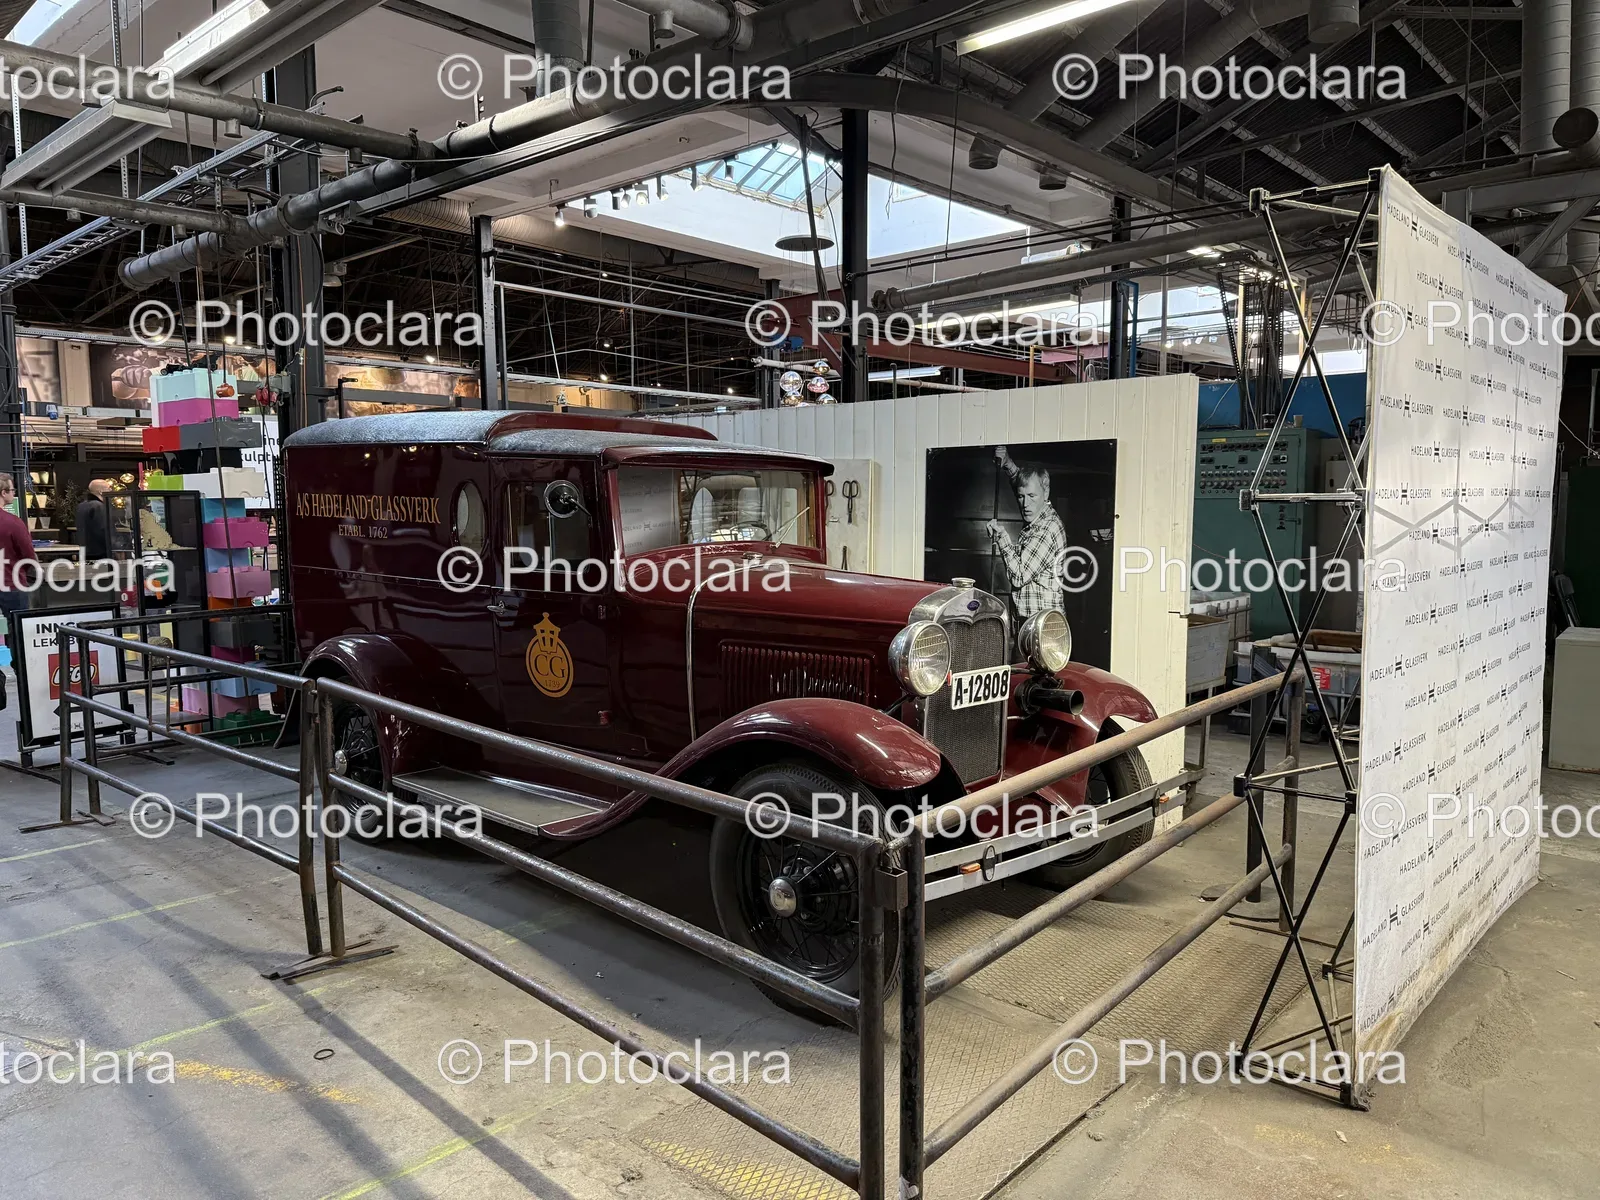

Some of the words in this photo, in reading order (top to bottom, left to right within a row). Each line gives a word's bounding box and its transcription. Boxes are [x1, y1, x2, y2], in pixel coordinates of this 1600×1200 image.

[296, 492, 310, 518] A/S
[338, 524, 366, 538] ETABL.
[368, 526, 388, 538] 1762
[1405, 612, 1429, 626] HADELAND
[1438, 603, 1458, 617] GLASSVERK
[534, 654, 566, 678] CG
[954, 670, 1010, 707] A-12808
[1364, 750, 1392, 772] HADELAND
[1402, 732, 1427, 752] GLASSVERK
[1400, 850, 1426, 876] HADELAND
[1434, 828, 1453, 851] GLASSVERK
[1362, 918, 1388, 949] HADELAND
[1401, 890, 1426, 917] GLASSVERK
